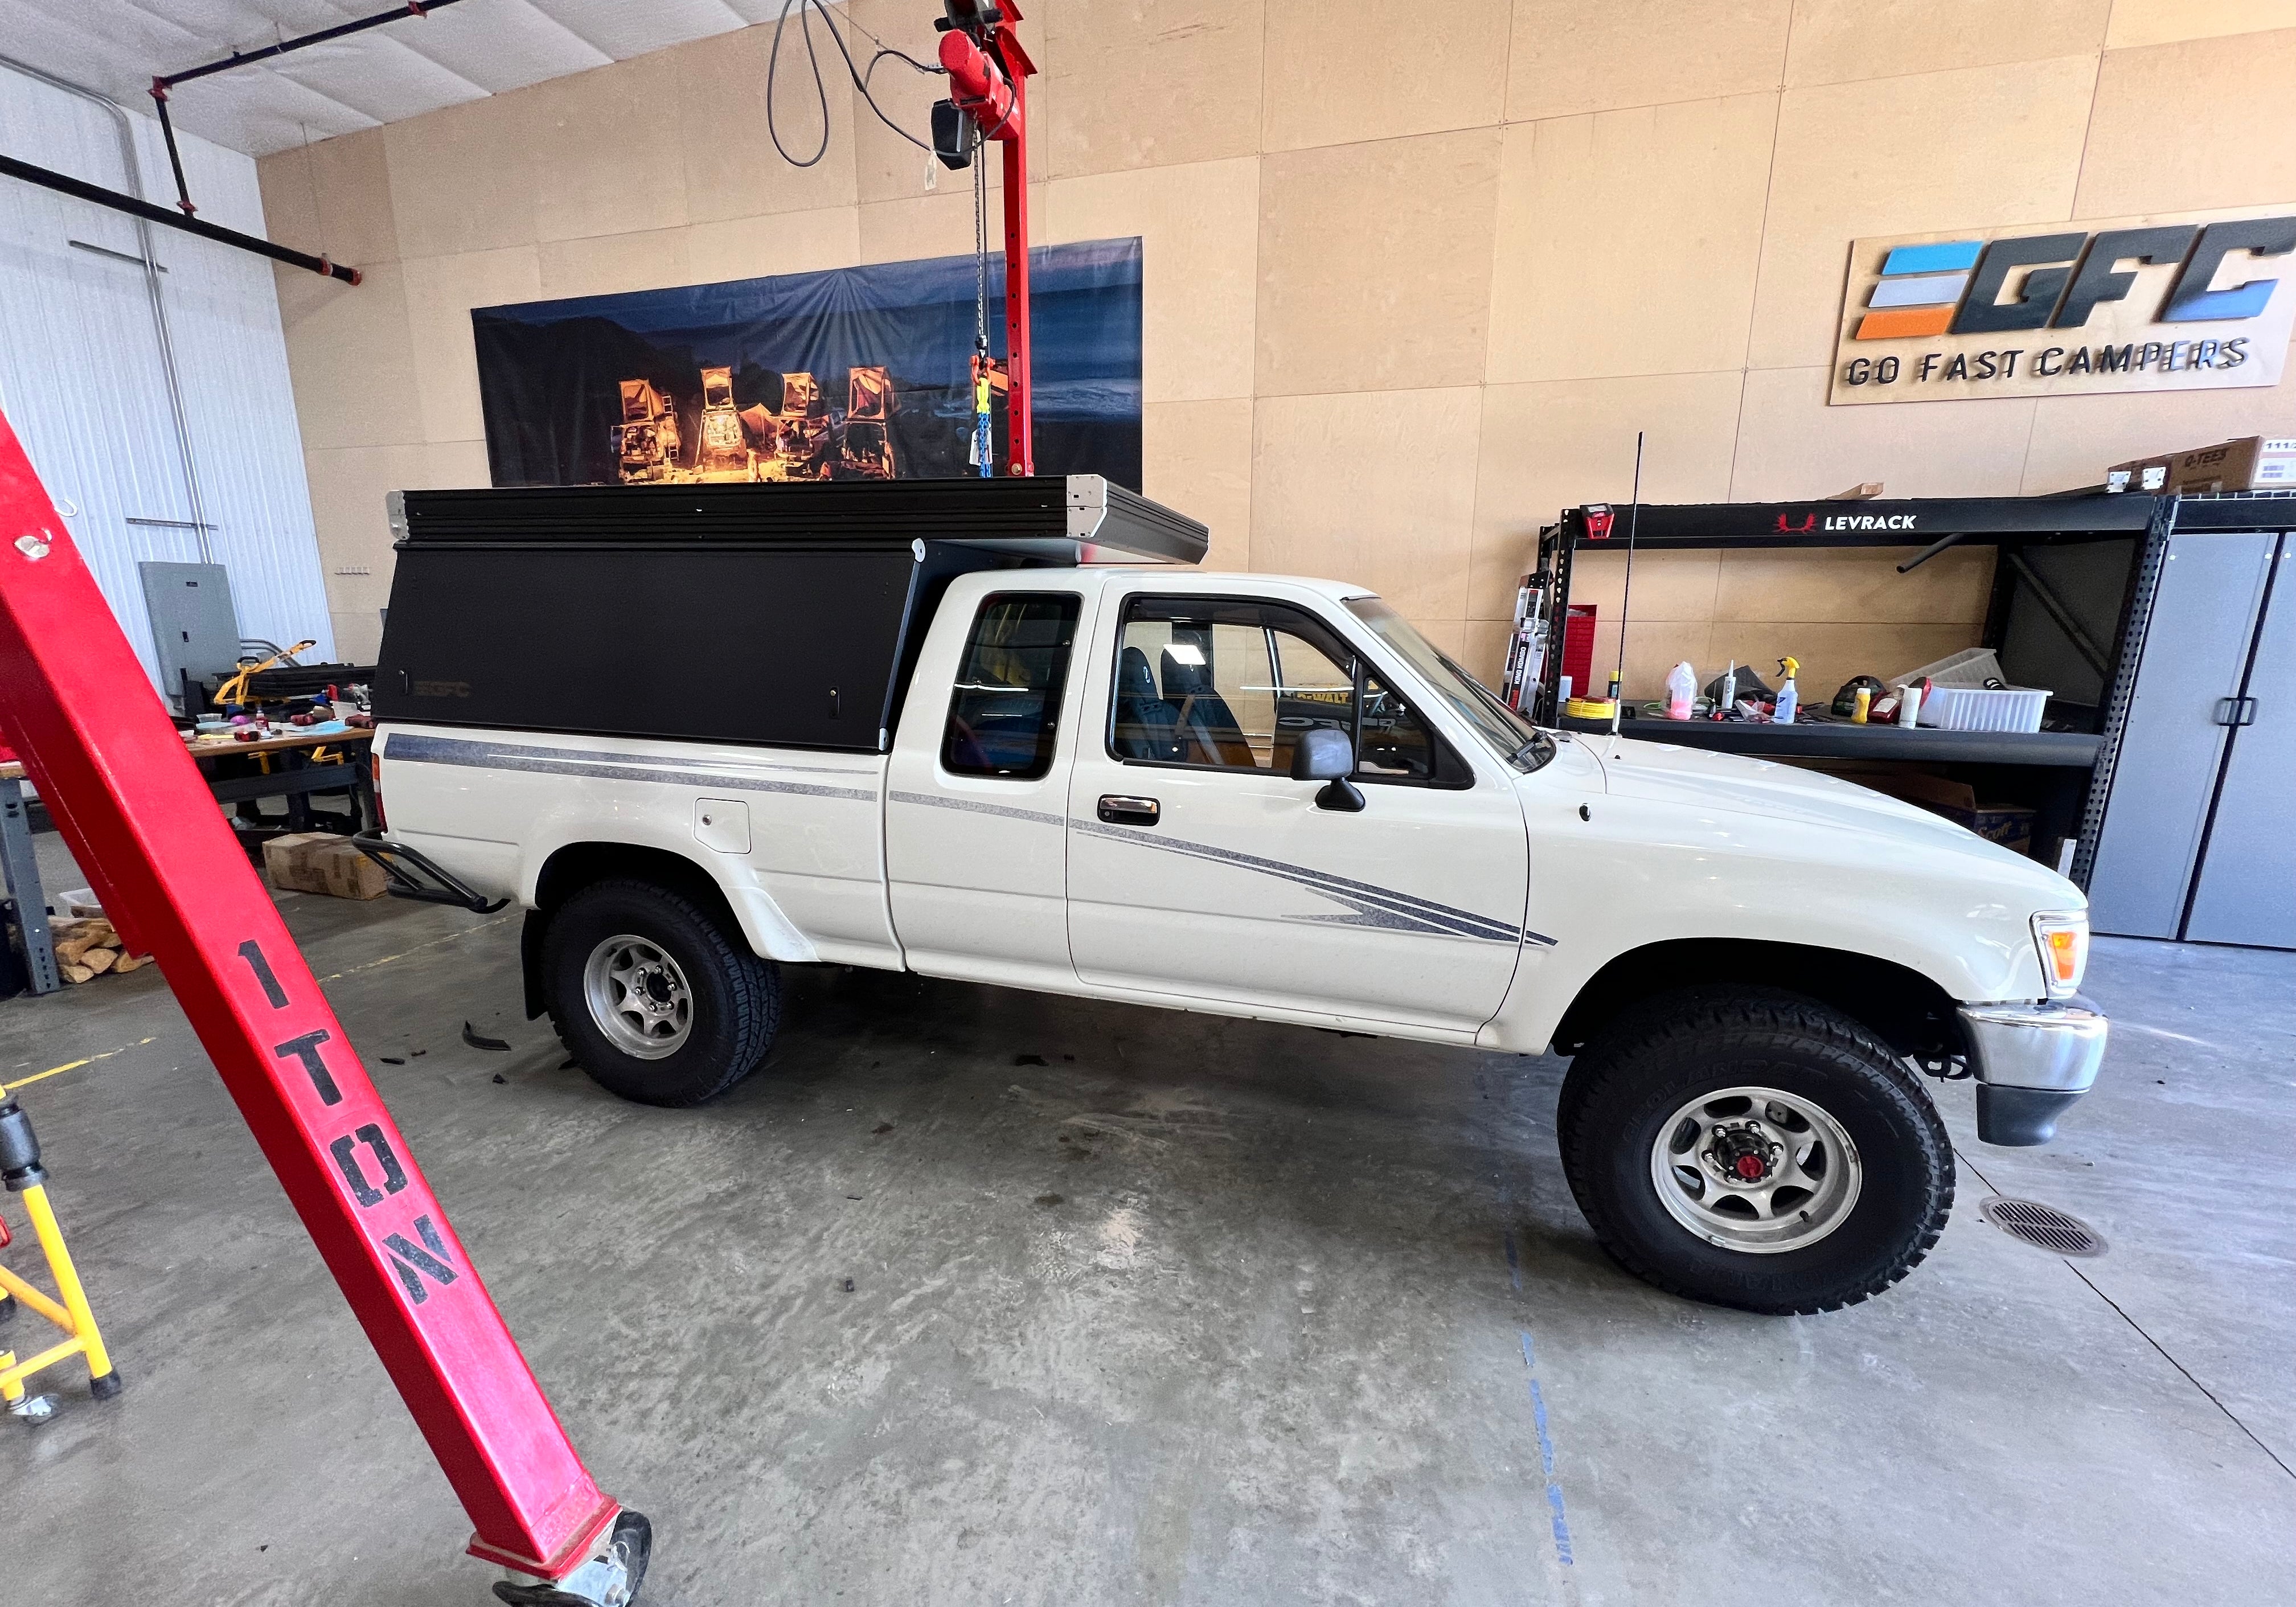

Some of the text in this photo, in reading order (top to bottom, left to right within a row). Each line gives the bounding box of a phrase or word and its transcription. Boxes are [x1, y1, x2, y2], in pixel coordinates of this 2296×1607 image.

[1950, 217, 2296, 334] GFC
[1848, 337, 2251, 386] GO FAST CAMPERS
[1824, 515, 1917, 531] LEVRACK
[1516, 647, 1527, 669] KOMBO
[1514, 669, 1523, 684] KING
[238, 940, 458, 1305] 1 TON
